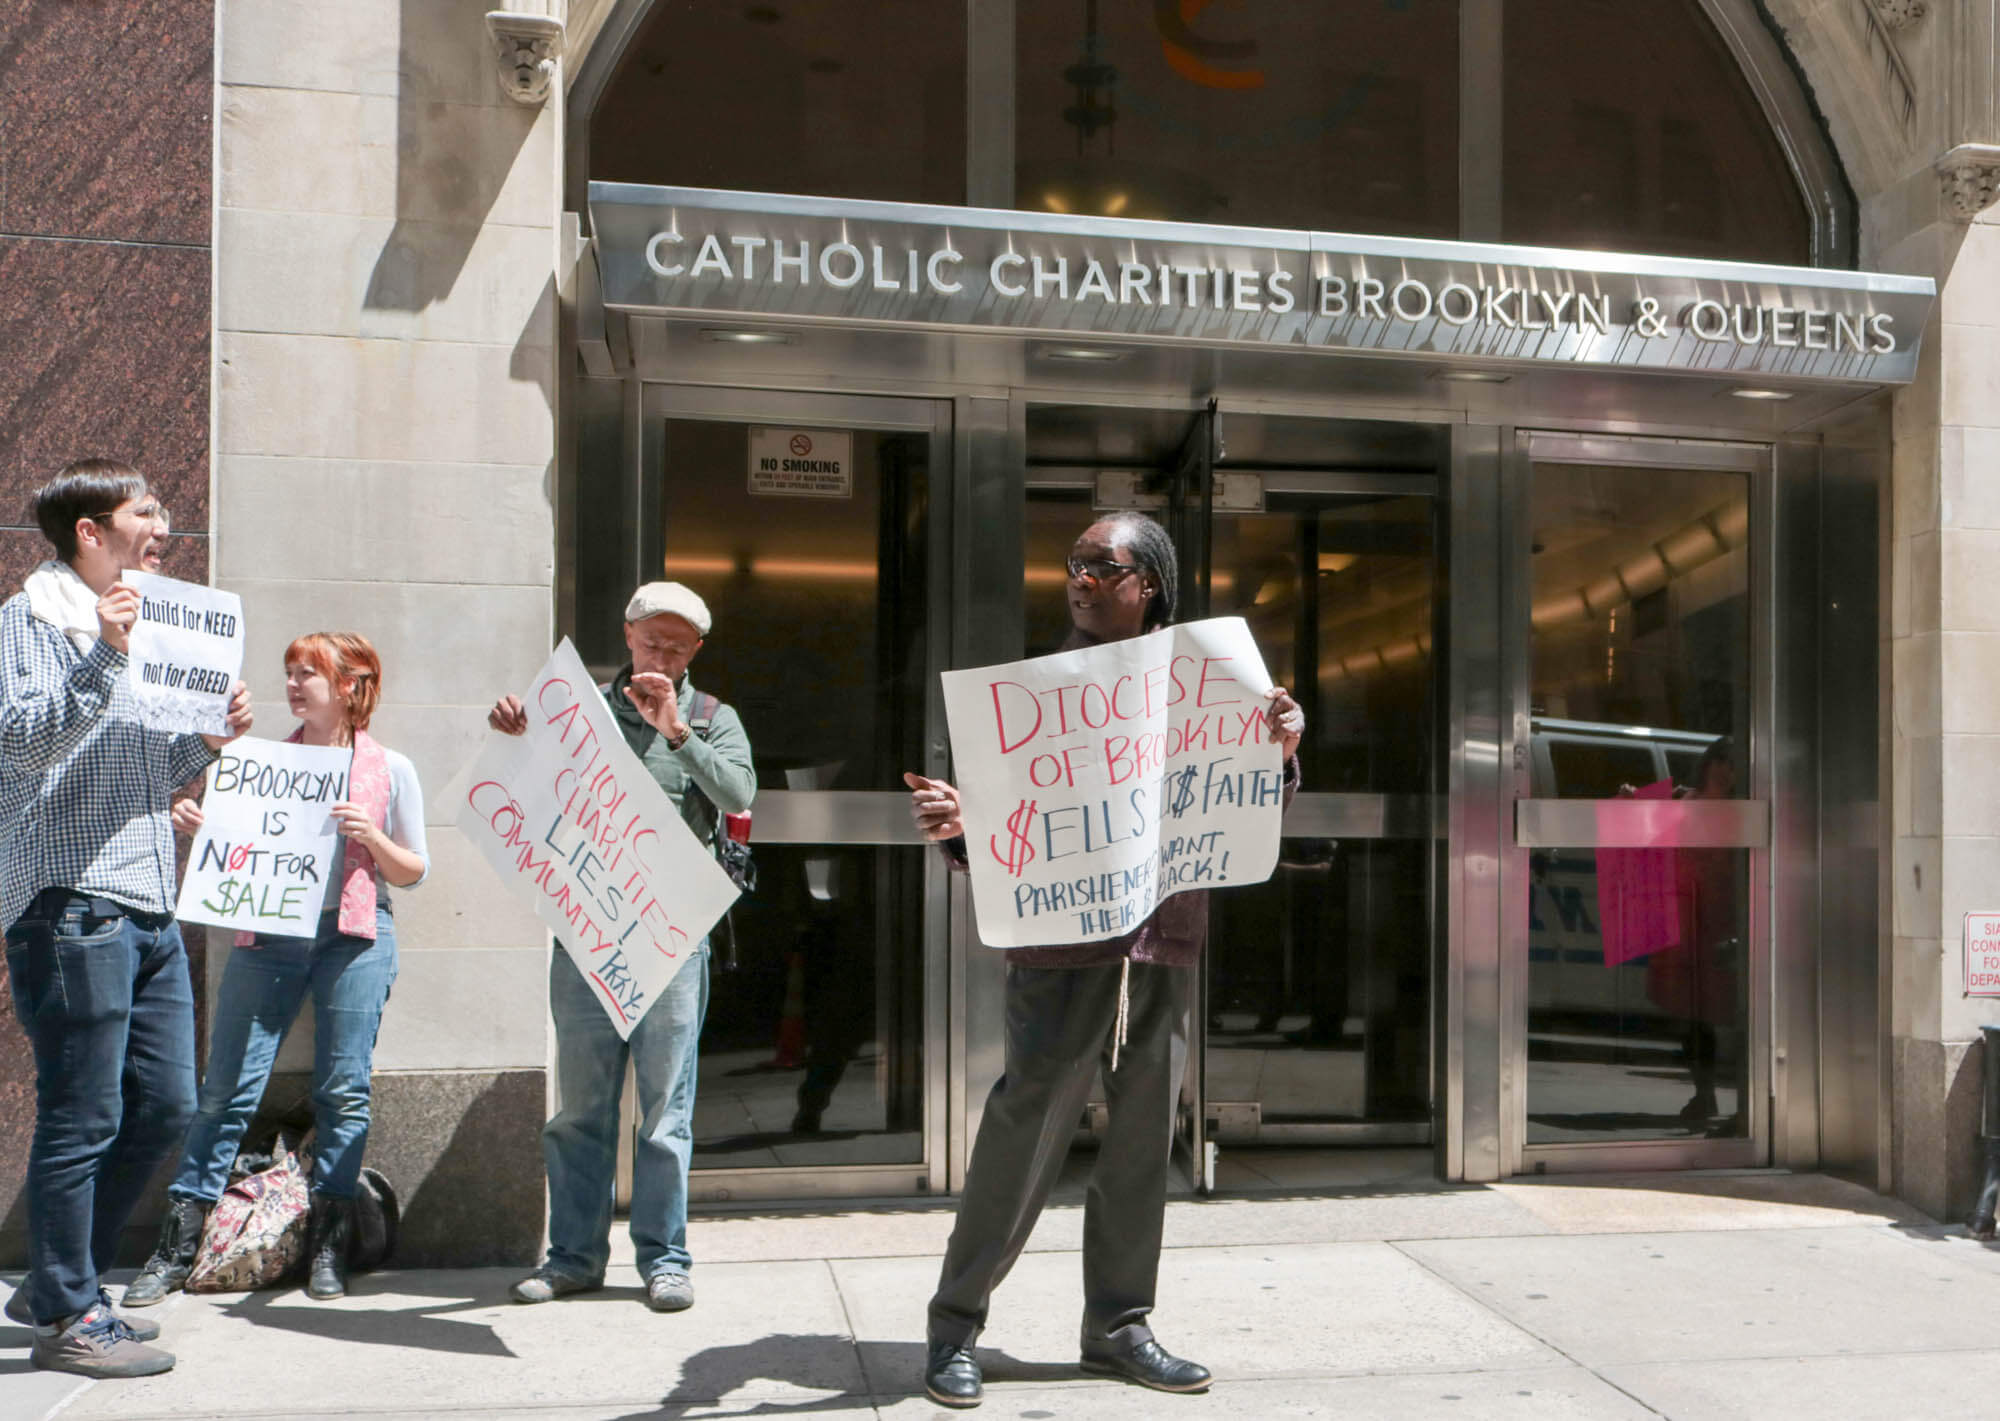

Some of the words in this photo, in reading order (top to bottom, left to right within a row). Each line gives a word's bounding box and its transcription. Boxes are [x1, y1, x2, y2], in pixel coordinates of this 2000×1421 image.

[645, 230, 963, 294] CATHOLIC
[989, 253, 1295, 314] CHARITIES
[1319, 275, 1612, 335] BROOKLYN
[1636, 296, 1669, 338] &
[1690, 300, 1897, 355] QUEENS
[760, 458, 778, 471] NO
[782, 459, 840, 474] SMOKING
[142, 597, 179, 628] build
[182, 606, 200, 630] for
[203, 611, 236, 638] NEED
[142, 662, 163, 686] not
[164, 663, 187, 689] for
[186, 667, 230, 695] GREED
[990, 656, 1241, 754] DIOCESE
[1029, 747, 1088, 788] OF
[1105, 706, 1272, 786] BROOKLYN
[214, 756, 343, 802] BROOKLYN
[538, 678, 660, 874] CATHOLIC
[1202, 757, 1282, 814] FAITH
[262, 812, 286, 836] IS
[273, 853, 319, 883] FOR
[468, 781, 613, 954] COMMUNITY
[554, 768, 688, 959] CHARITIES
[1161, 832, 1224, 868] WANT
[202, 876, 308, 920] $ALE
[545, 814, 640, 947] LIES!
[1072, 900, 1136, 936] THEIR
[1157, 851, 1230, 901] BACK!
[1971, 939, 2000, 952] CON
